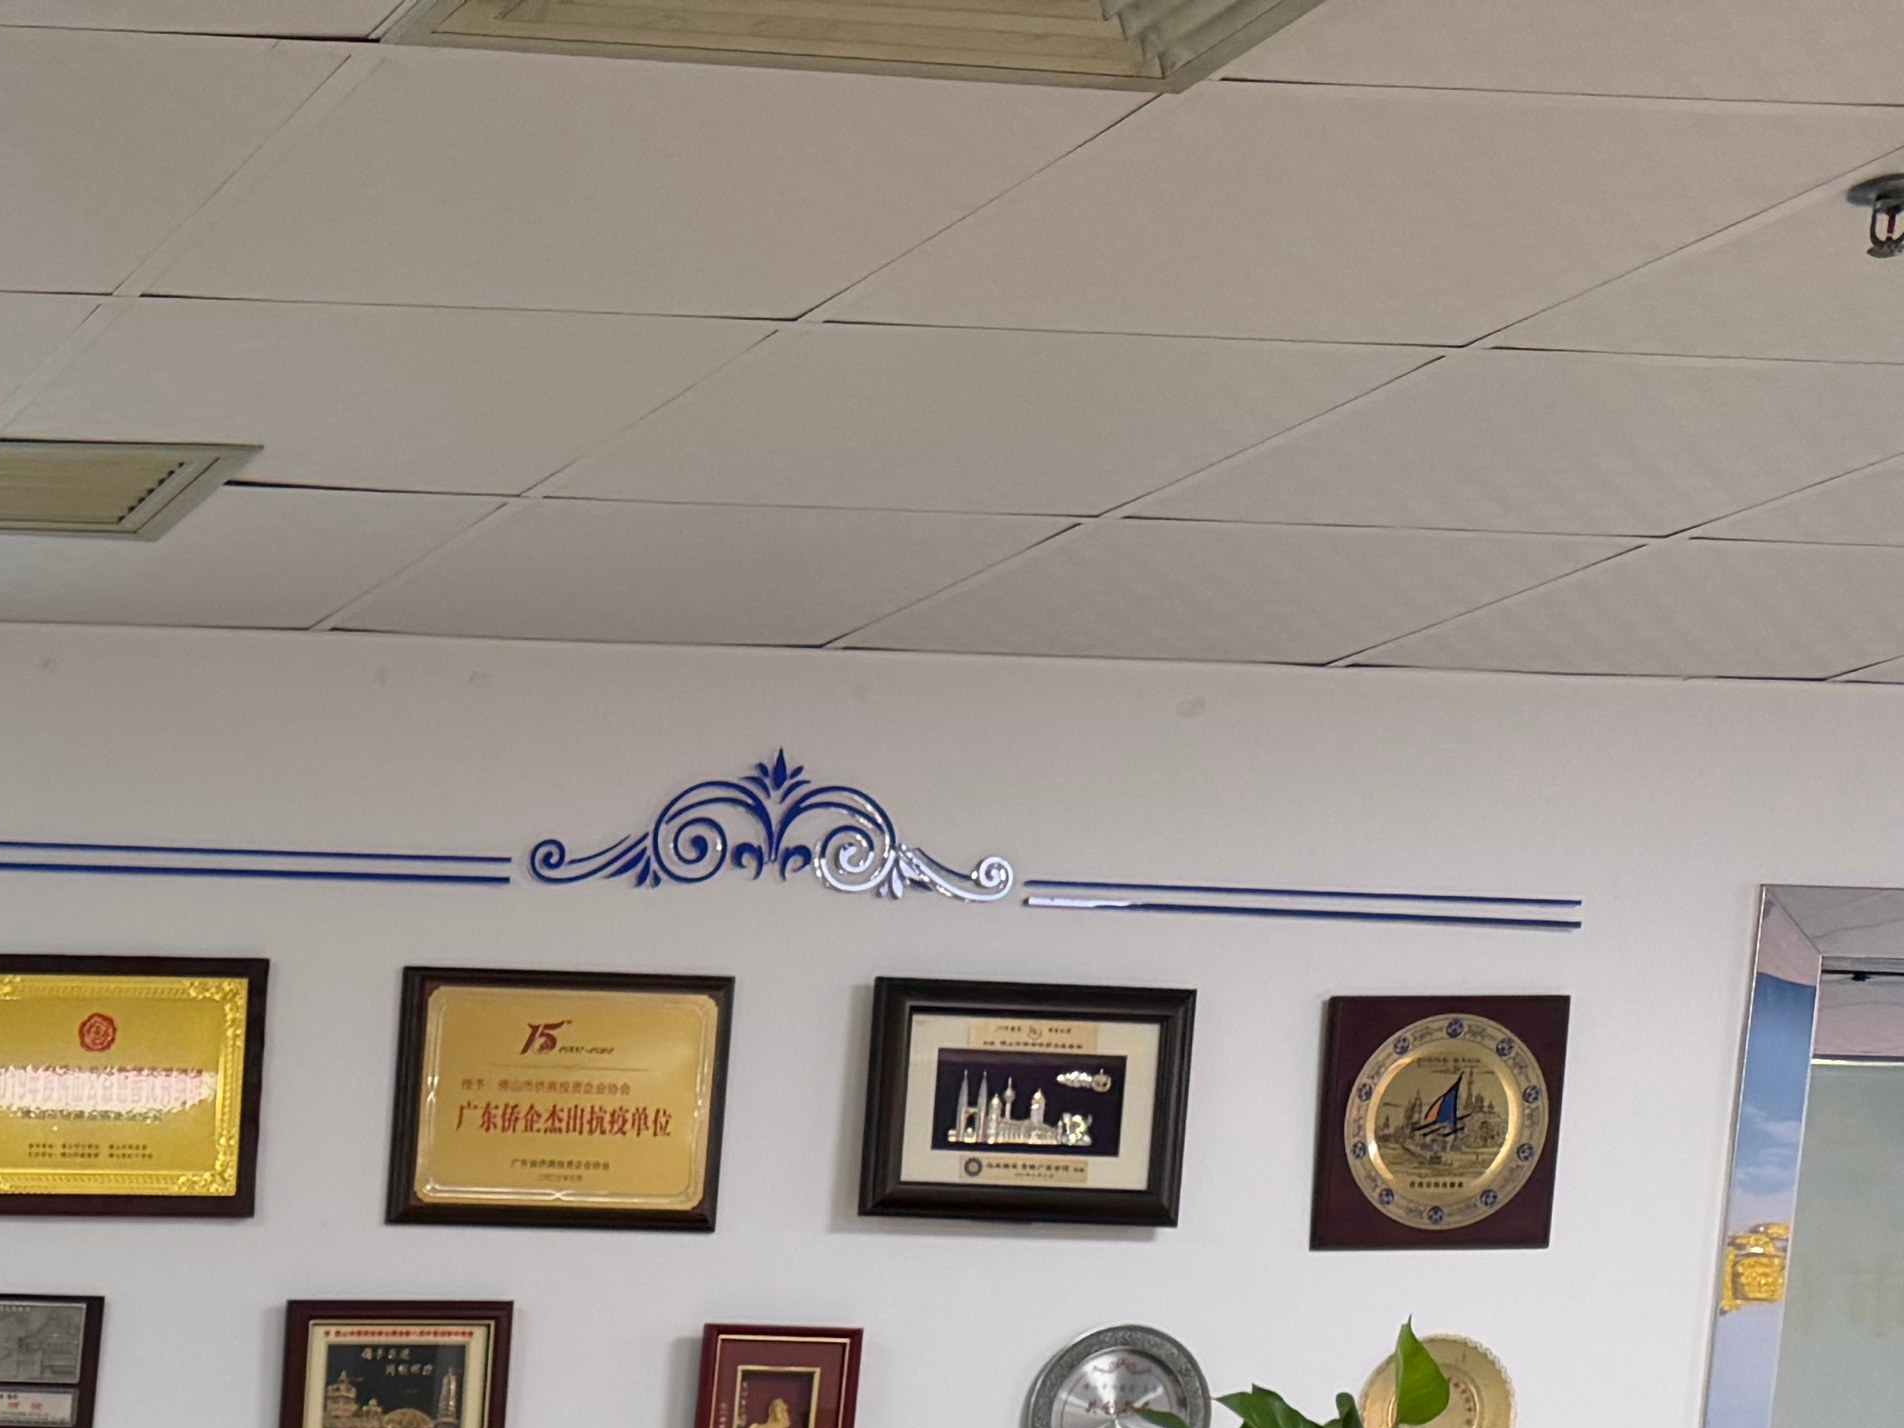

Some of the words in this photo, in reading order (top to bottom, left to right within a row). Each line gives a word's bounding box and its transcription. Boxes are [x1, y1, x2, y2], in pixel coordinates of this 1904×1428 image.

[456, 1102, 672, 1137] 广东侨企杰出抗疫单位
